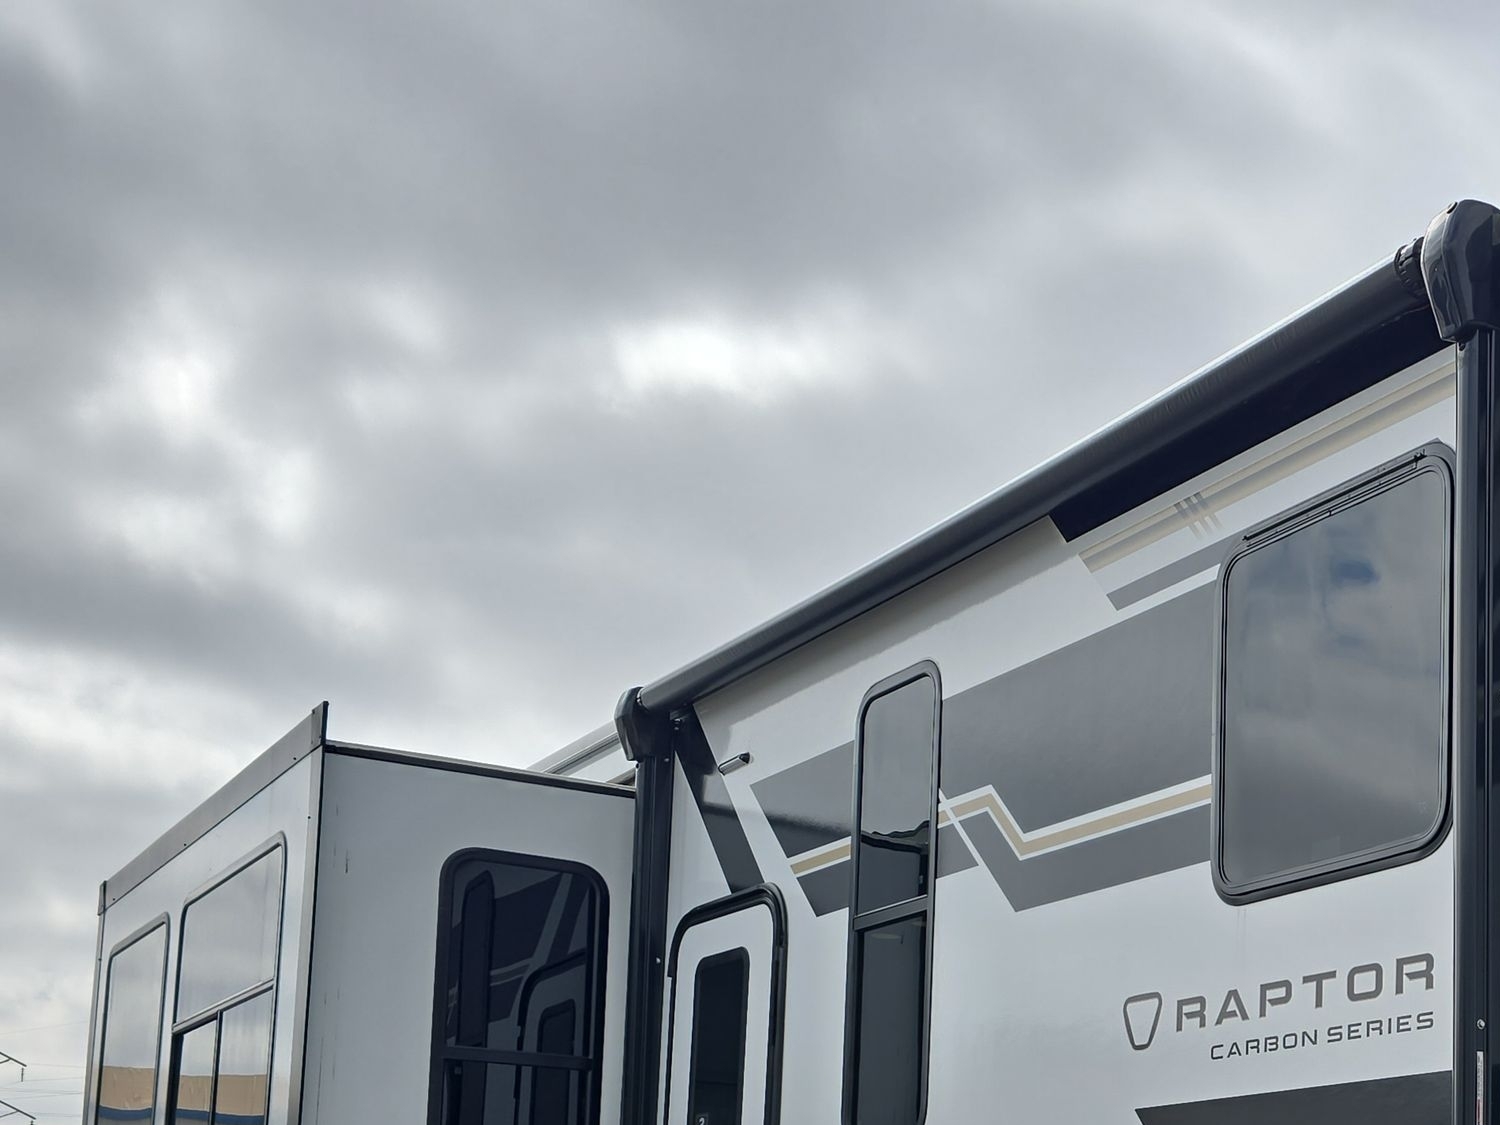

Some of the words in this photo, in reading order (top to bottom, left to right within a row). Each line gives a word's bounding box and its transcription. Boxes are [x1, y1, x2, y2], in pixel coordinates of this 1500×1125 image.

[1175, 952, 1435, 1033] RAPTOR
[1210, 1029, 1318, 1060] CARBON
[1327, 1011, 1435, 1043] SERIES
